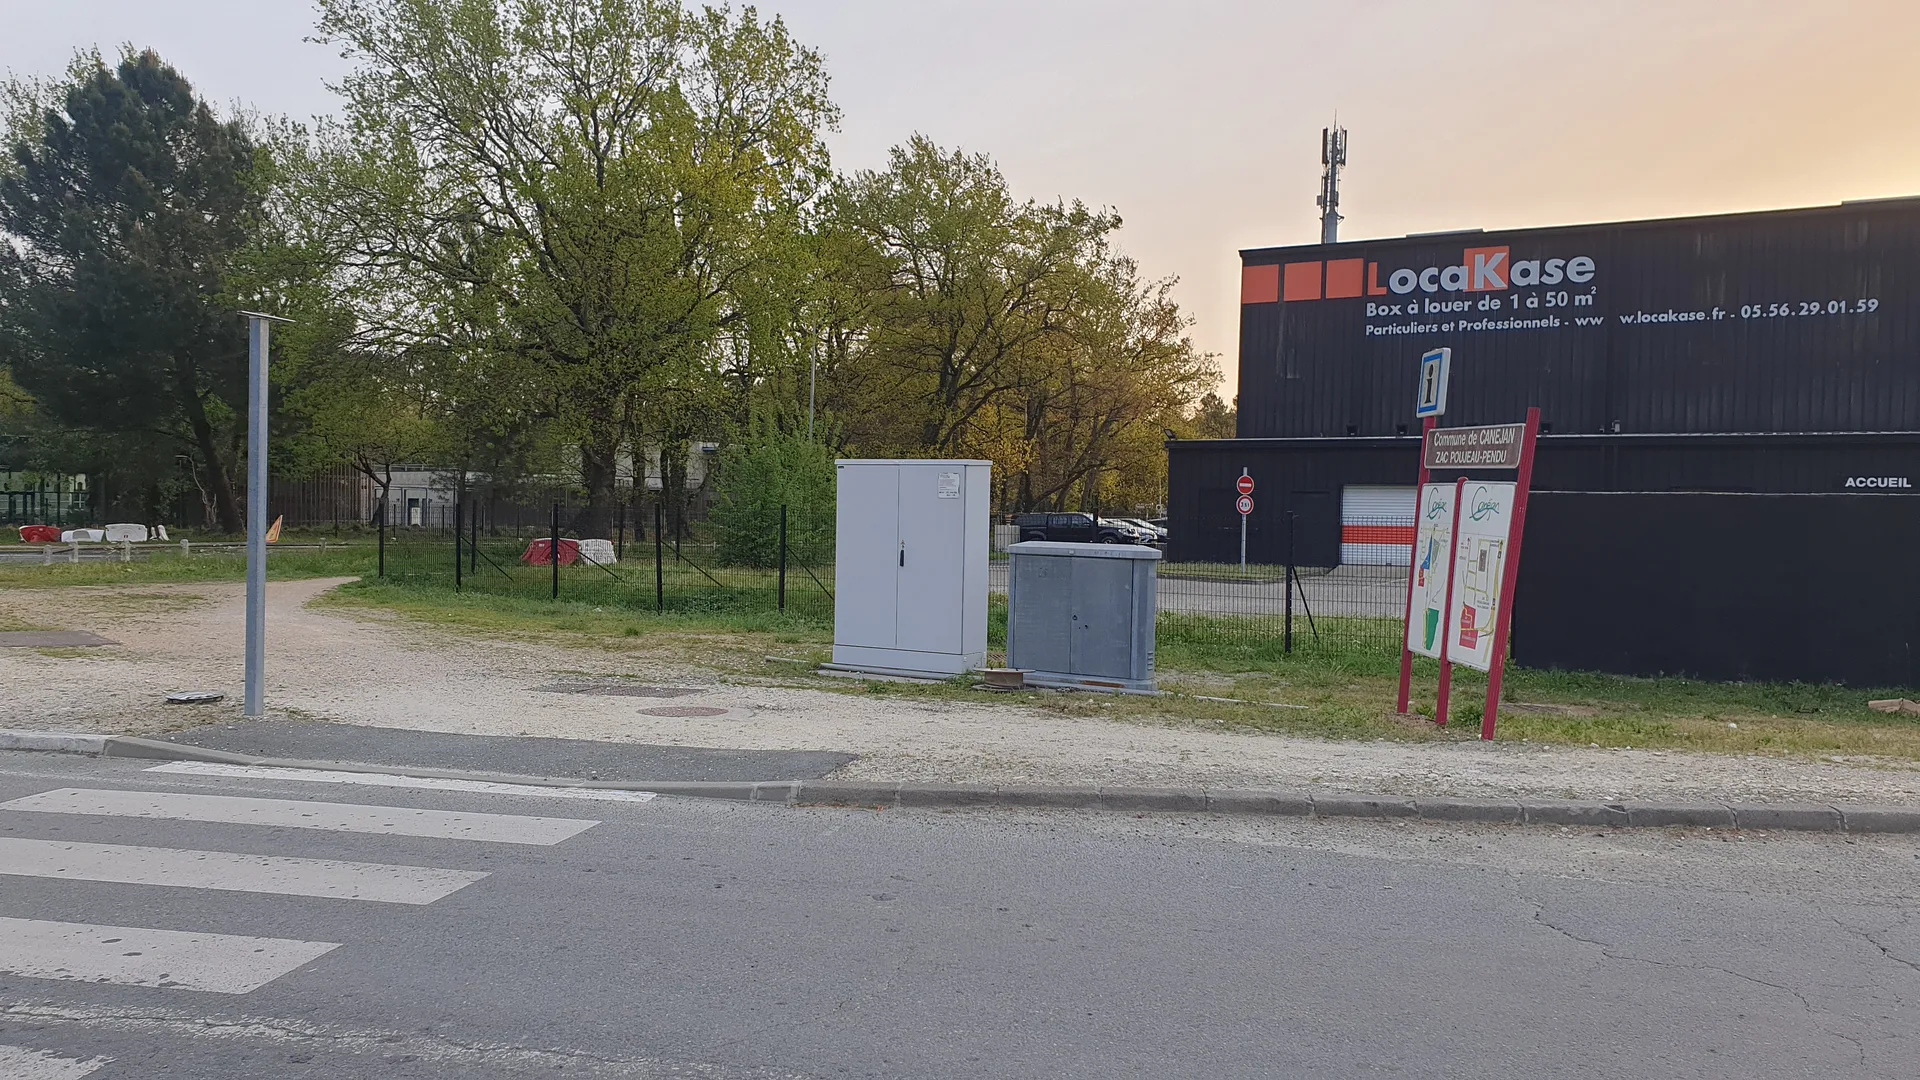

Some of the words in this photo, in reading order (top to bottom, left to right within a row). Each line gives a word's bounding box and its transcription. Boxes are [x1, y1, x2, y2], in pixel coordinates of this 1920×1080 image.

[1367, 252, 1596, 296] LocaKase
[1366, 302, 1402, 317] Box
[1407, 299, 1419, 315] à
[1424, 297, 1472, 314] louer
[1477, 295, 1502, 311] de
[1509, 293, 1519, 309] 1
[1525, 292, 1539, 308] à
[1545, 291, 1569, 307] 50
[1365, 318, 1438, 336] Particuliers
[1441, 319, 1455, 332] et
[1458, 315, 1561, 332] Professionnels
[1619, 307, 1726, 325] w.locakase.fr
[1740, 298, 1879, 319] 05.56.29.01.59
[1433, 431, 1466, 447] Commune
[1468, 430, 1478, 447] de
[1479, 427, 1516, 445] CANEJAN
[1435, 451, 1449, 464] ZAC
[1449, 449, 1507, 464] POUJEAU-PENDU
[1844, 477, 1912, 488] ACCUEIL
